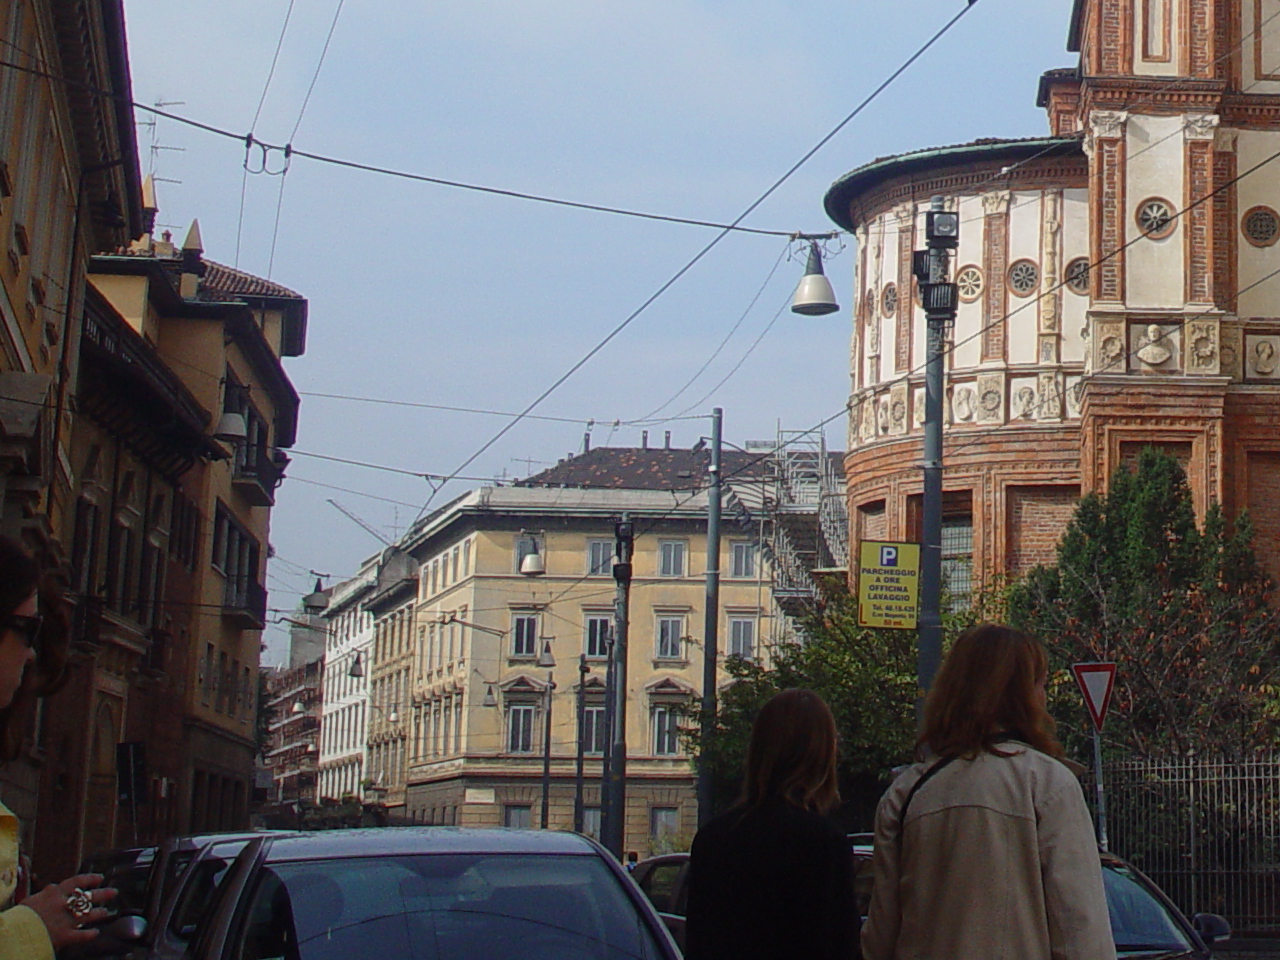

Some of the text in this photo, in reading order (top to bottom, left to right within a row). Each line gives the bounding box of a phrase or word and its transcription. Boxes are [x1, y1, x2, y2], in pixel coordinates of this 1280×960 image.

[882, 546, 897, 565] P
[861, 568, 916, 577] PARCHEGGIO
[883, 576, 900, 584] ORE
[867, 593, 910, 601] LAVAGGIO
